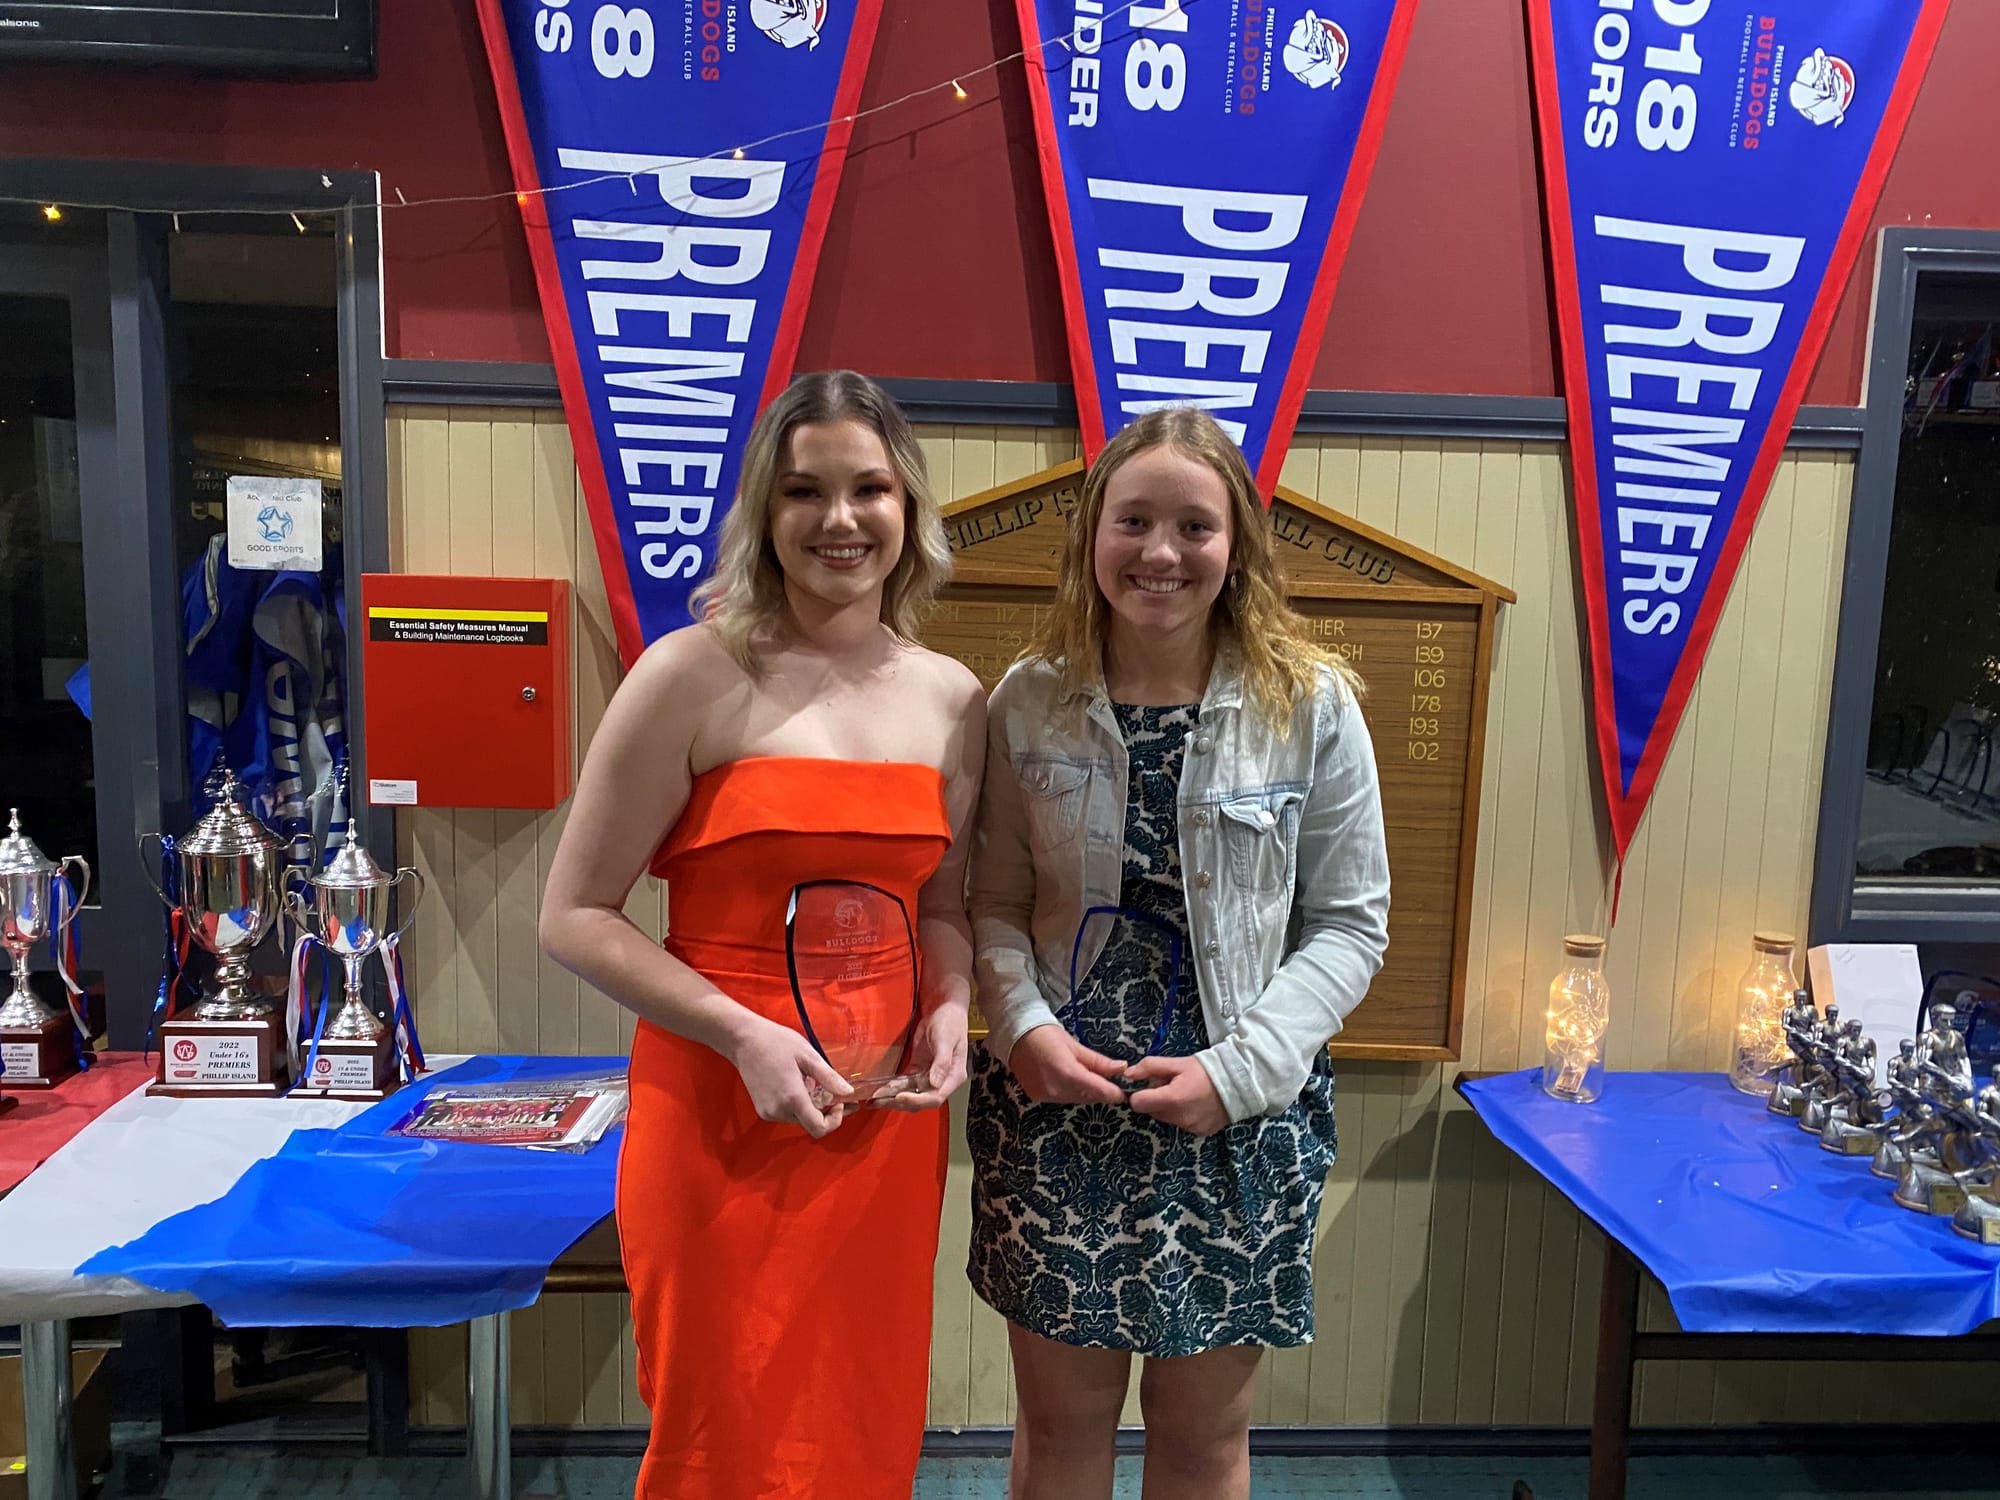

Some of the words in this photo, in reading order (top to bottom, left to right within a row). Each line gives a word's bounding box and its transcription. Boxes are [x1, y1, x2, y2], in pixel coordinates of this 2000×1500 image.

[0, 18, 40, 27] alsonic
[534, 0, 573, 53] S
[591, 4, 655, 79] 8
[684, 0, 692, 45] ETBALL
[701, 0, 720, 81] DOGS
[727, 5, 736, 52] ISLAND
[1265, 7, 1275, 48] PHILLIP
[1740, 14, 1753, 64] FOOTBALL
[684, 51, 692, 80] CLUB
[1125, 0, 1188, 111] 18
[1226, 41, 1236, 85] NETBALL
[1239, 0, 1262, 115] ULLDOGS
[1261, 51, 1271, 91] ISLAND
[1583, 0, 1634, 148] IORS
[1773, 45, 1785, 85] PHILLIP
[1224, 88, 1232, 113] CLUB
[1733, 77, 1744, 120] NETBALL
[1744, 16, 1776, 149] BULLDOGS
[1767, 87, 1779, 127] ISLAND
[1729, 122, 1739, 148] CLUB
[1087, 178, 1308, 446] PREM
[557, 147, 786, 579] PREMIERS
[1594, 215, 1806, 635] PREMIERS
[943, 500, 1043, 552] HILLIP
[247, 544, 272, 552] GOOD
[1322, 535, 1396, 584] CLUB
[389, 620, 428, 630] Essential
[429, 622, 455, 632] Safety
[457, 623, 497, 632] Measures
[499, 624, 529, 632] Manual
[394, 631, 401, 639] &
[402, 632, 434, 641] Building
[435, 633, 485, 641] Maintenance
[486, 634, 524, 642] Logbooks
[1312, 619, 1345, 636] HER
[1416, 622, 1443, 639] 137
[1317, 643, 1363, 661] TOSH
[1415, 645, 1444, 664] 139
[1414, 669, 1446, 688] 106
[1412, 694, 1441, 713] 178
[1409, 717, 1439, 736] 193
[1408, 741, 1440, 760] 102
[207, 1061, 251, 1069] PREMIERS
